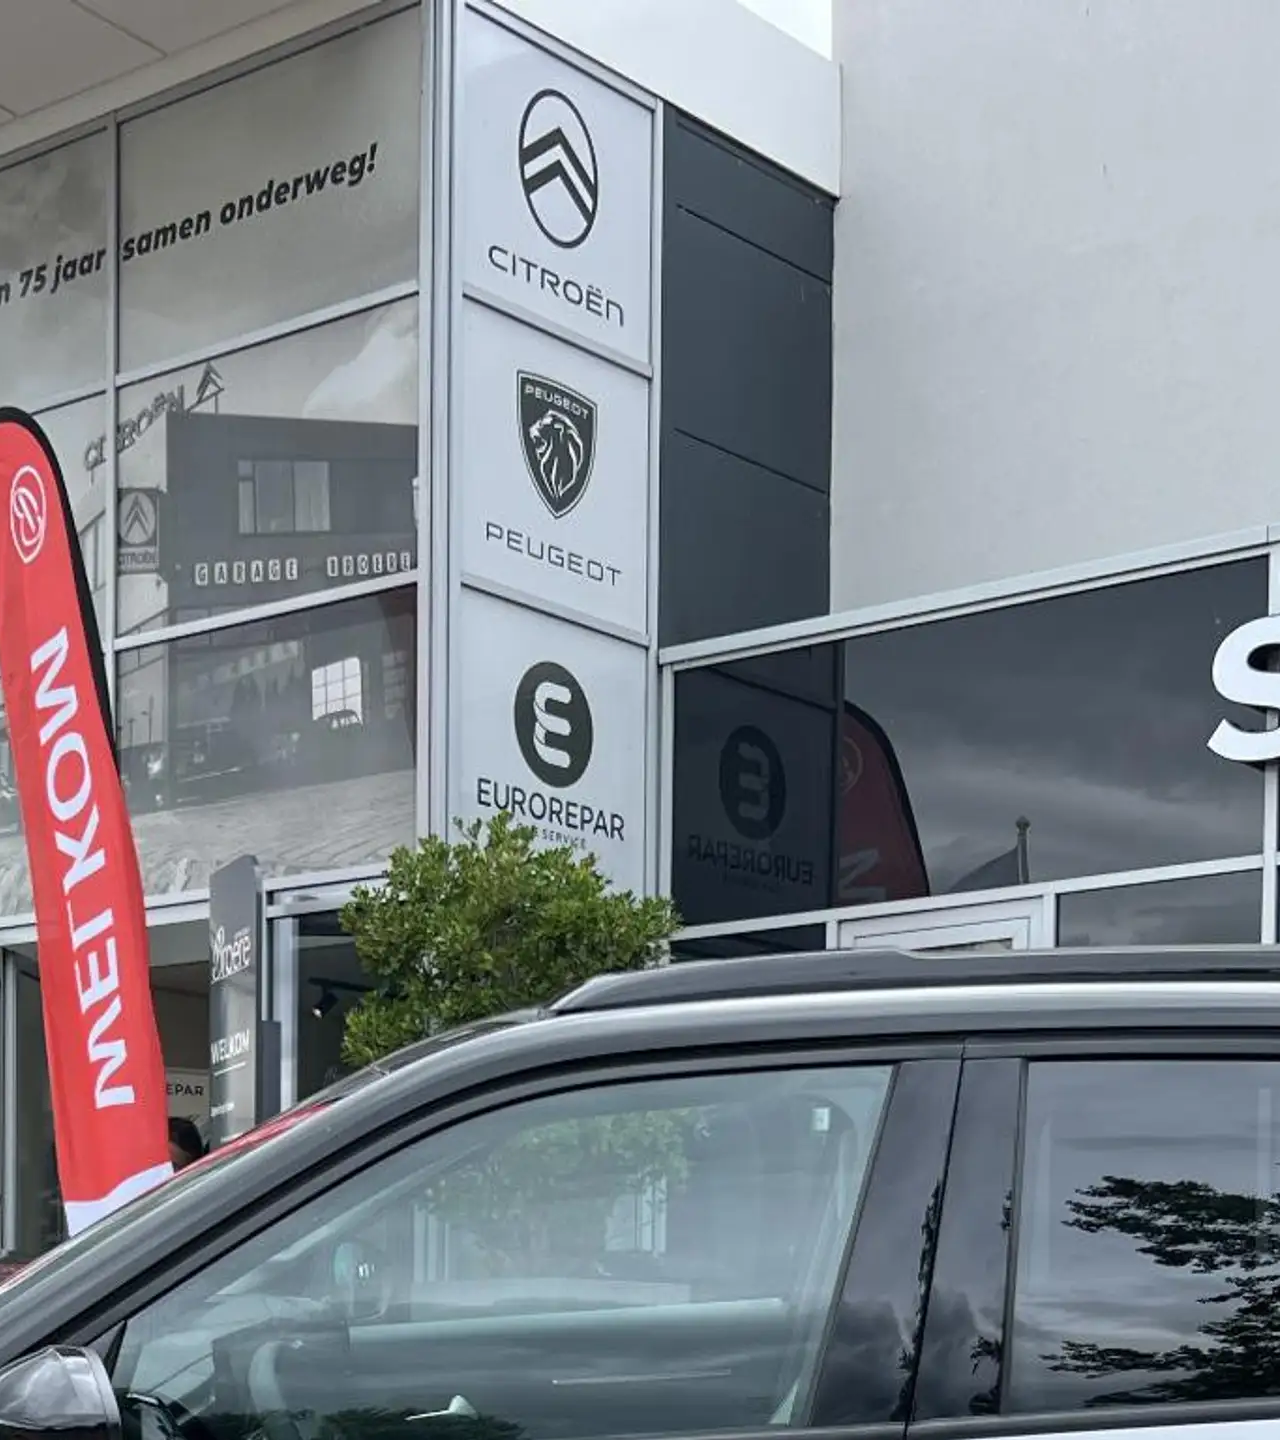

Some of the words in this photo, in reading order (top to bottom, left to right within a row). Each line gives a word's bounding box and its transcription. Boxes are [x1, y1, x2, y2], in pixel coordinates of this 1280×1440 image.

[19, 262, 48, 298] 75
[50, 247, 108, 294] jaar
[121, 209, 212, 262] samen
[220, 142, 378, 226] onderweg!
[524, 383, 590, 420] PEUGEOT
[194, 557, 299, 586] GARAGE
[485, 520, 623, 587] PEUGEOT
[476, 776, 626, 842] EUROREPAR
[165, 1083, 204, 1096] EPAR
